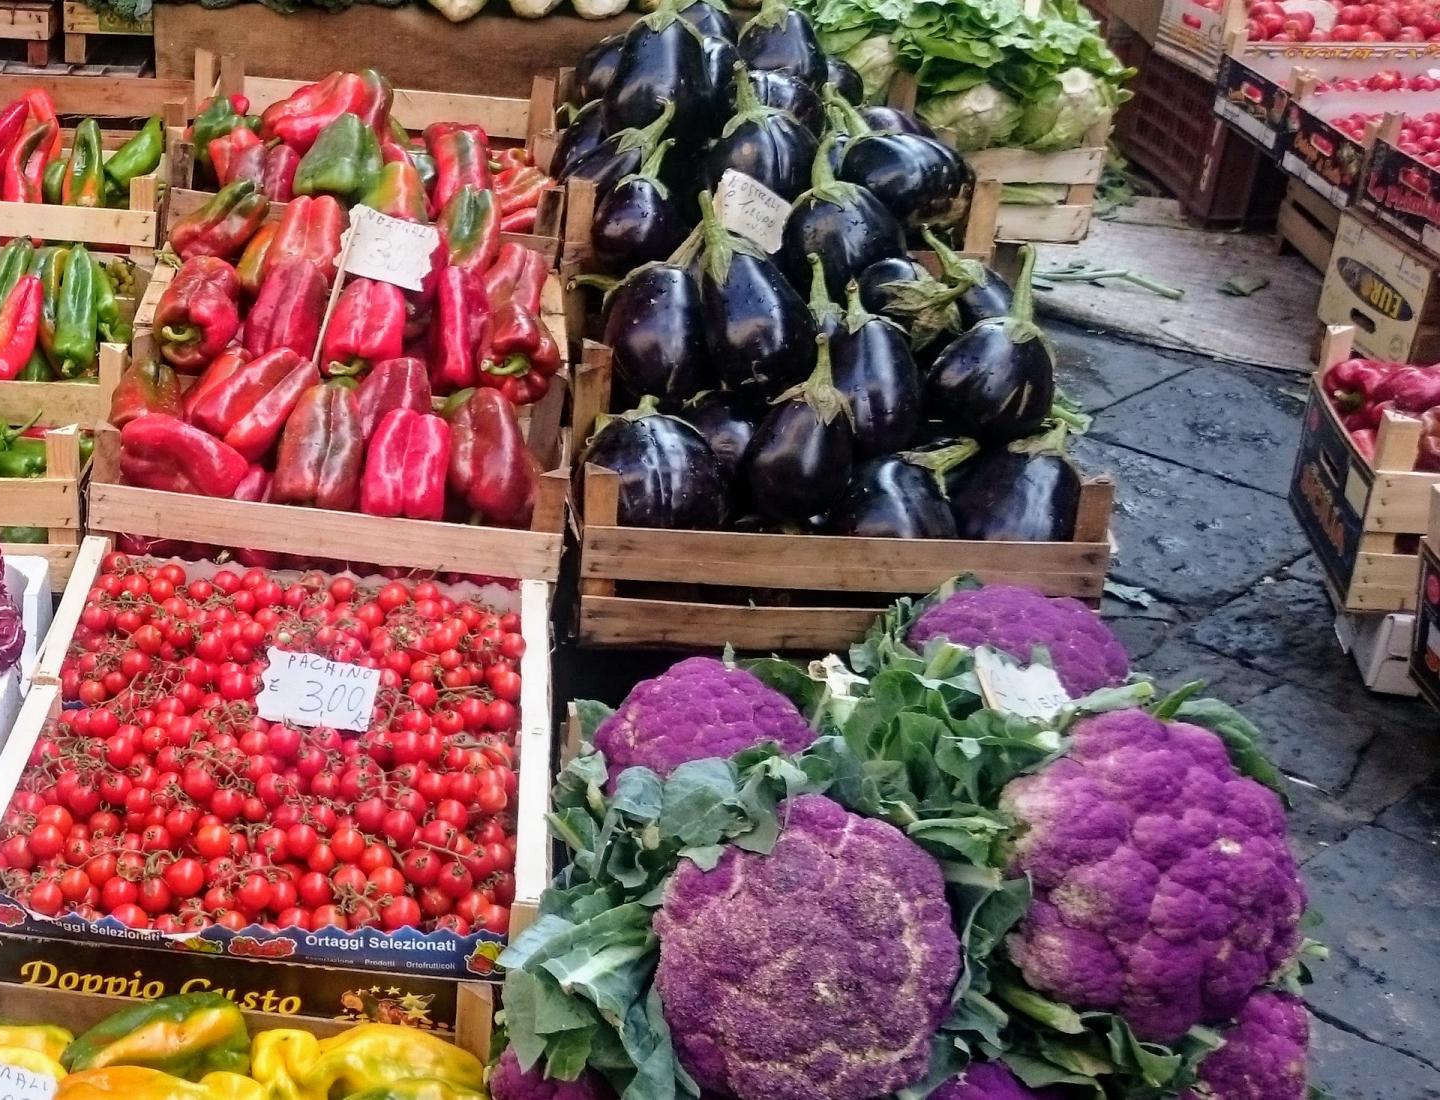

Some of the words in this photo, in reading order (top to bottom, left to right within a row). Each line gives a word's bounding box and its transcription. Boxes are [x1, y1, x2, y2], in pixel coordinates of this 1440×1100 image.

[287, 654, 373, 680] PACHINO
[89, 923, 161, 941] Selezionati
[305, 935, 364, 950] Ortaggi
[368, 937, 456, 952] Selezionati
[364, 958, 395, 967] Prodotti
[20, 959, 165, 1000] Doppio
